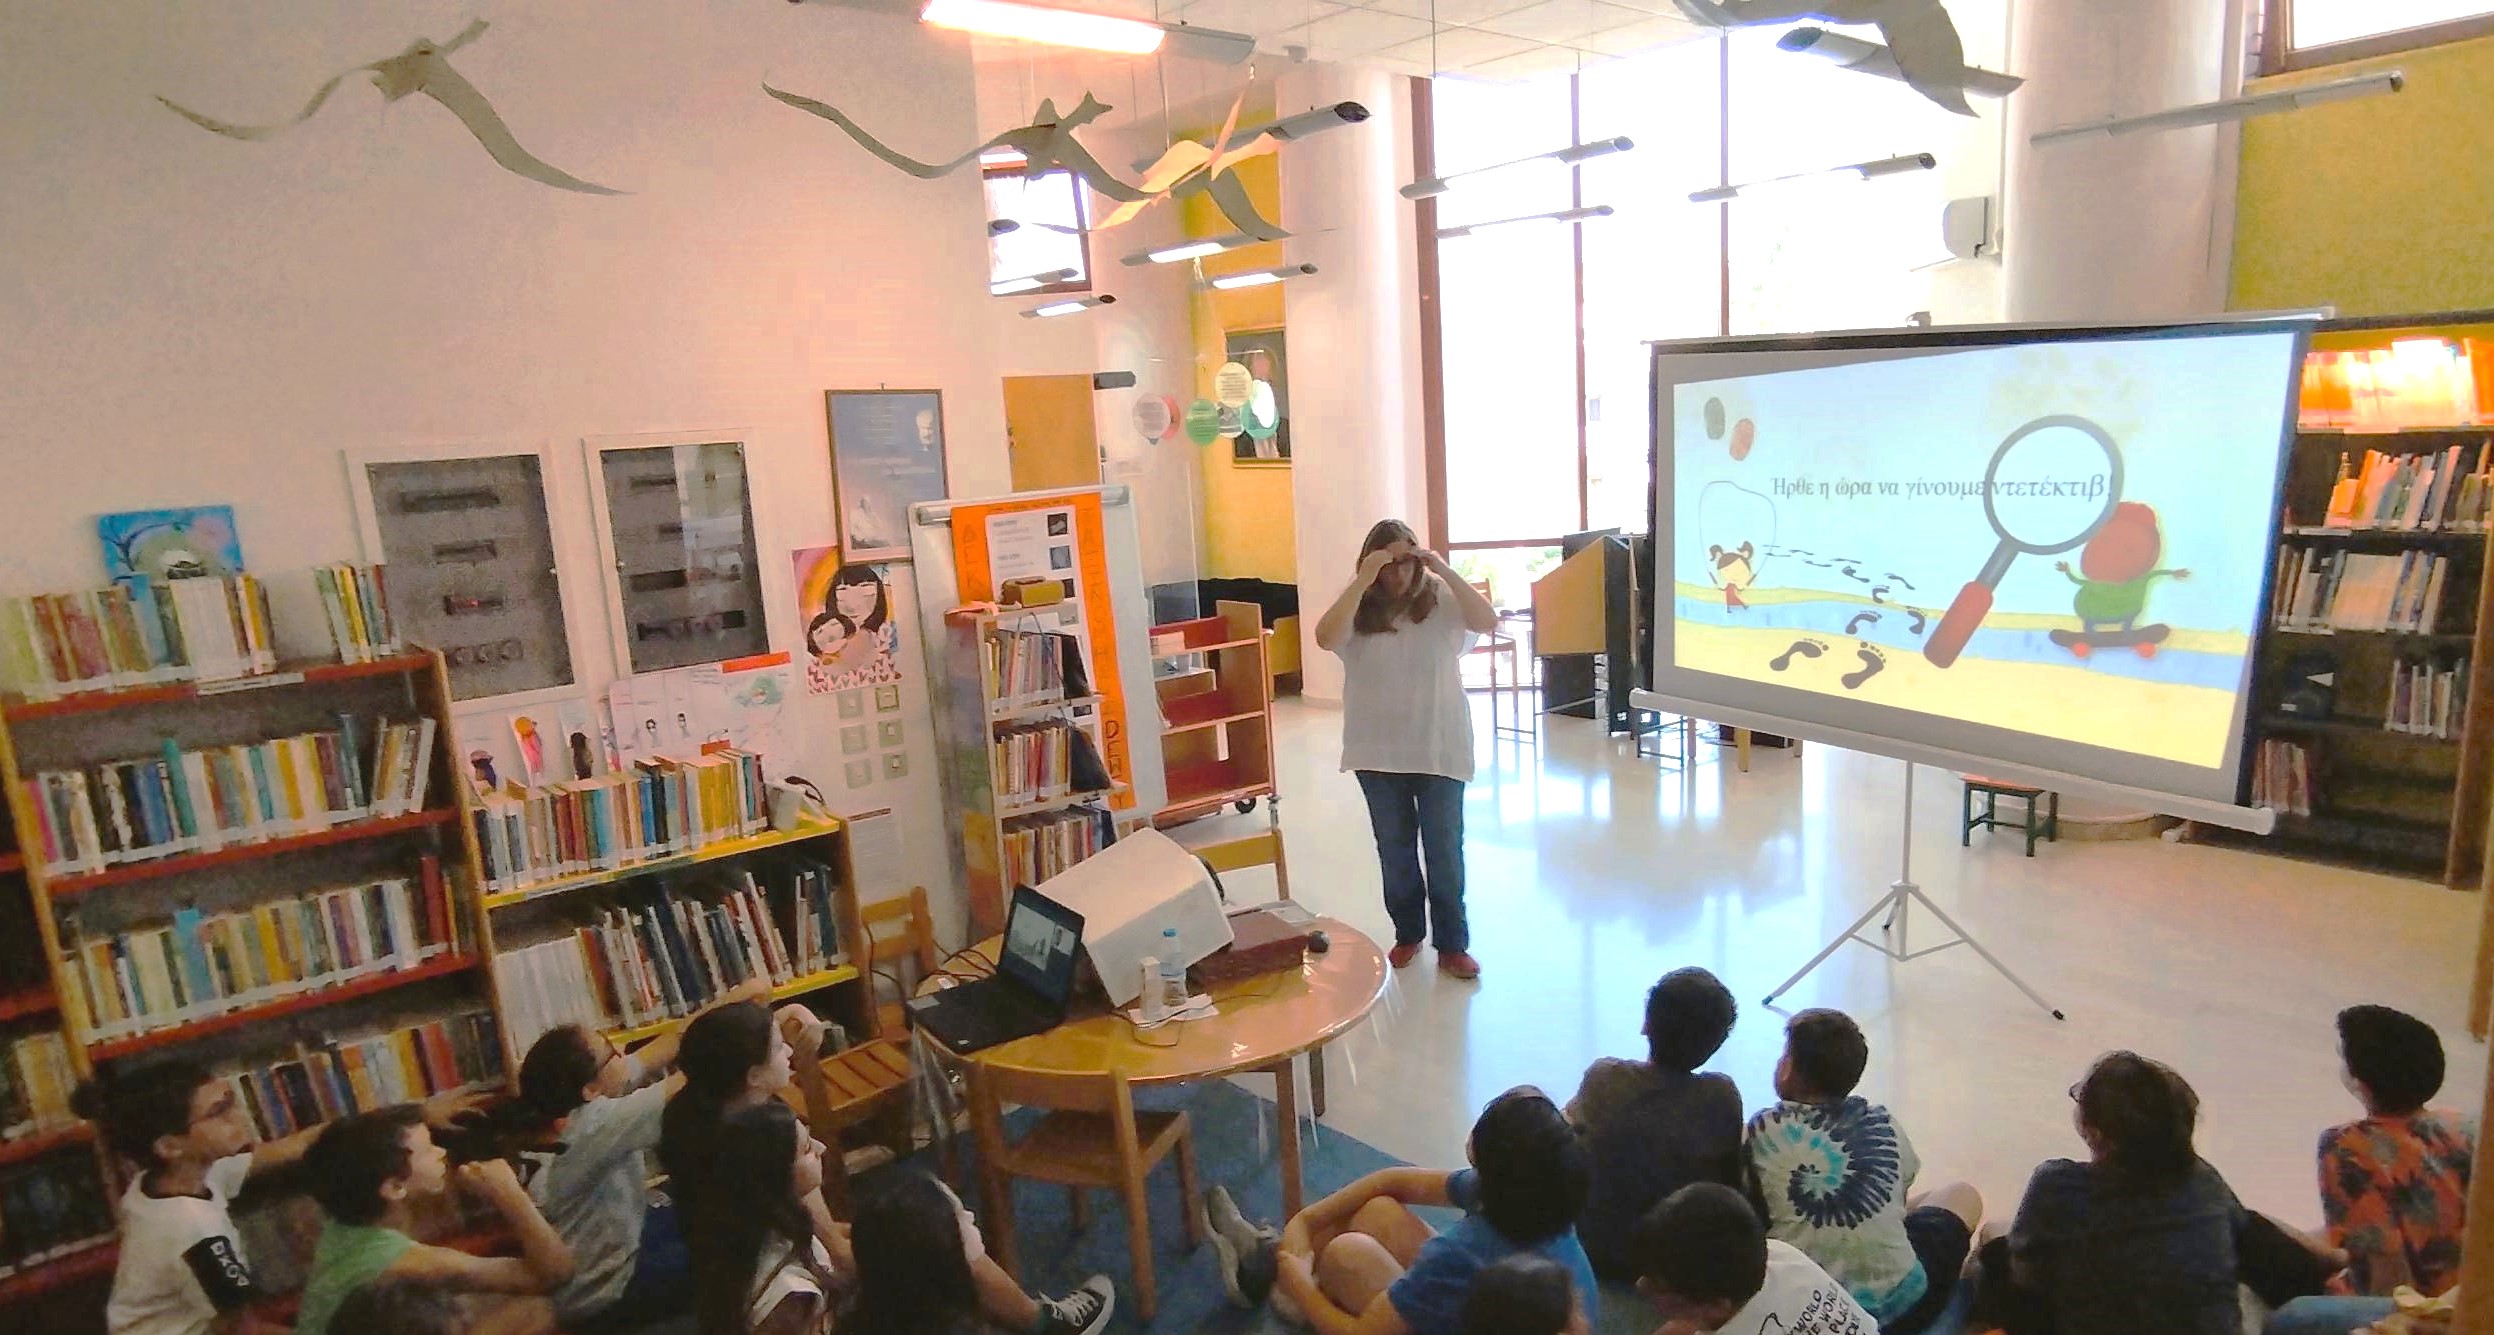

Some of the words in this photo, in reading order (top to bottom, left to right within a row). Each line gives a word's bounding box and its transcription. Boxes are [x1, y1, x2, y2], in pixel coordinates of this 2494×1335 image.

[1771, 477, 1814, 500] Ήρθε
[1819, 480, 1829, 500] η
[1835, 477, 1872, 500] ώρα
[1878, 480, 1899, 496] να
[1905, 476, 1985, 500] γίνουμε
